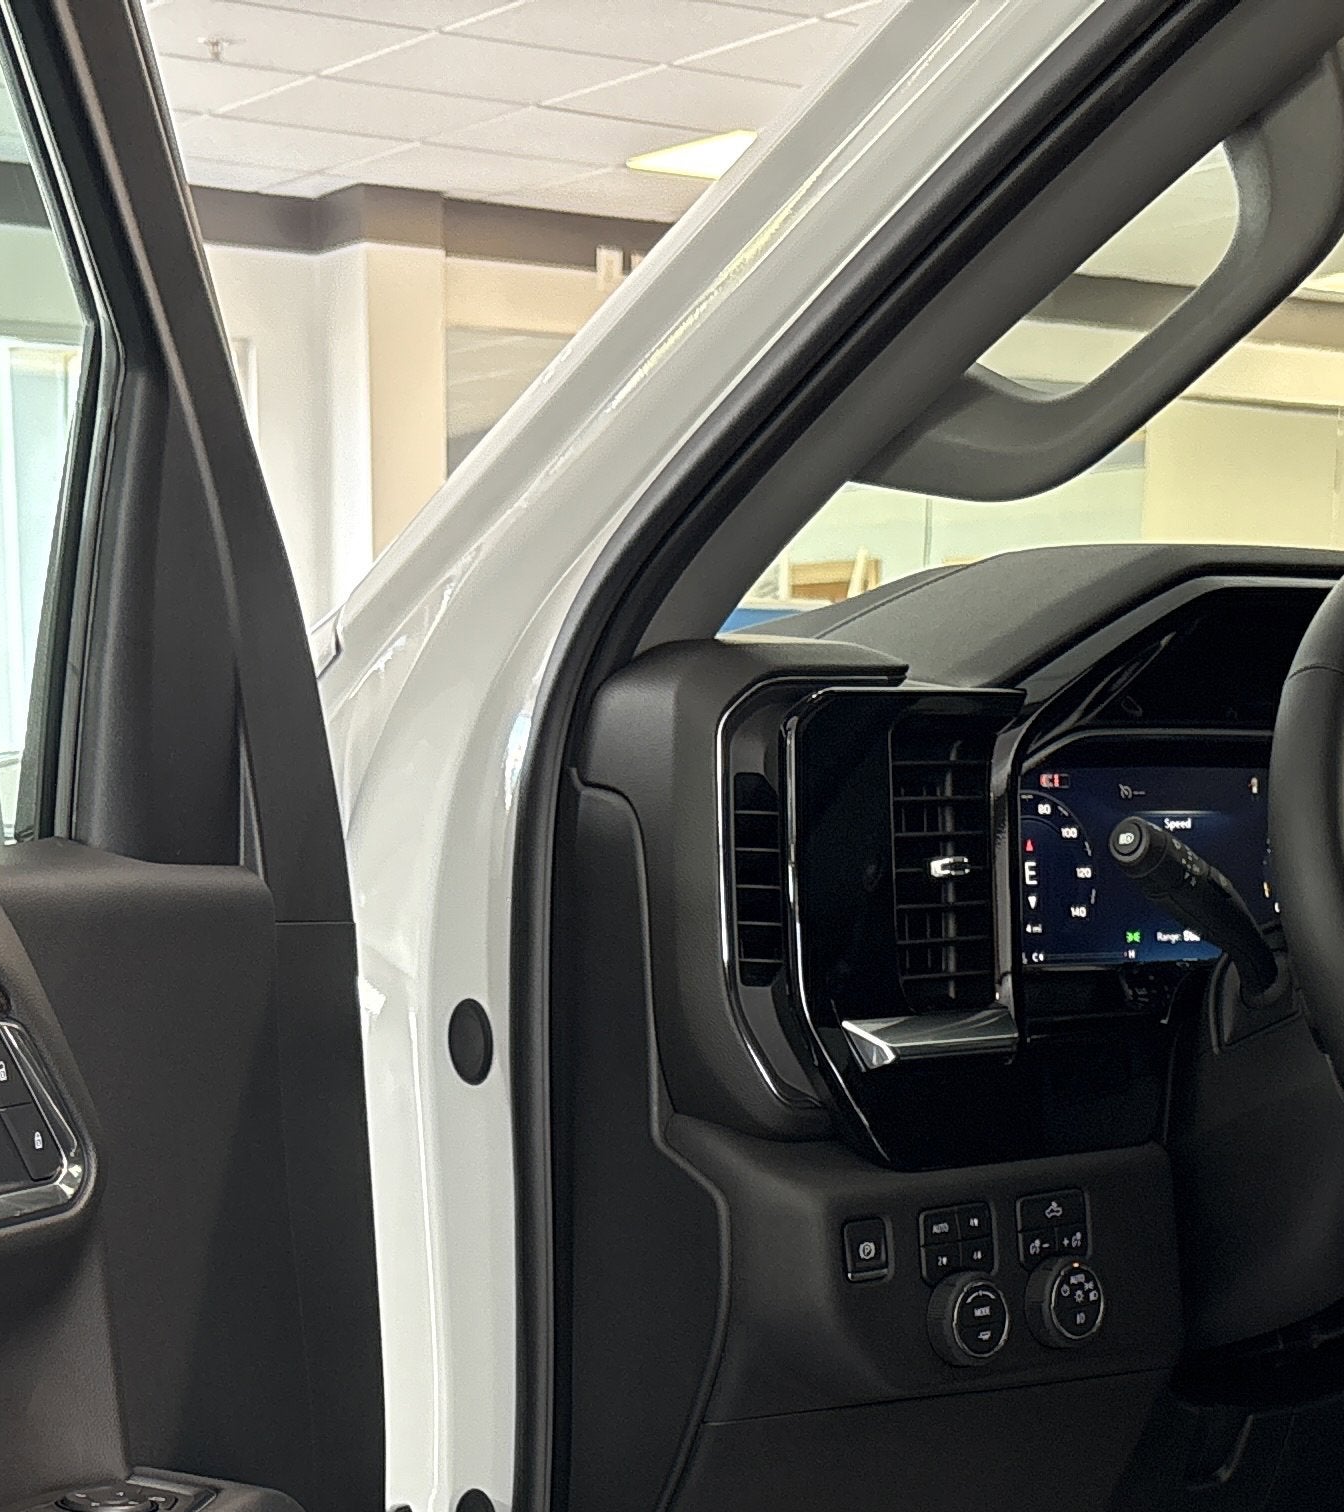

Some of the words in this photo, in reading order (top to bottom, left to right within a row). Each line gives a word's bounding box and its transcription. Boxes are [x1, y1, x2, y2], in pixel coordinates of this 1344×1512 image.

[1164, 817, 1192, 831] Speed
[1060, 827, 1078, 839] 100
[1024, 861, 1038, 886] E
[1070, 906, 1087, 918] 140
